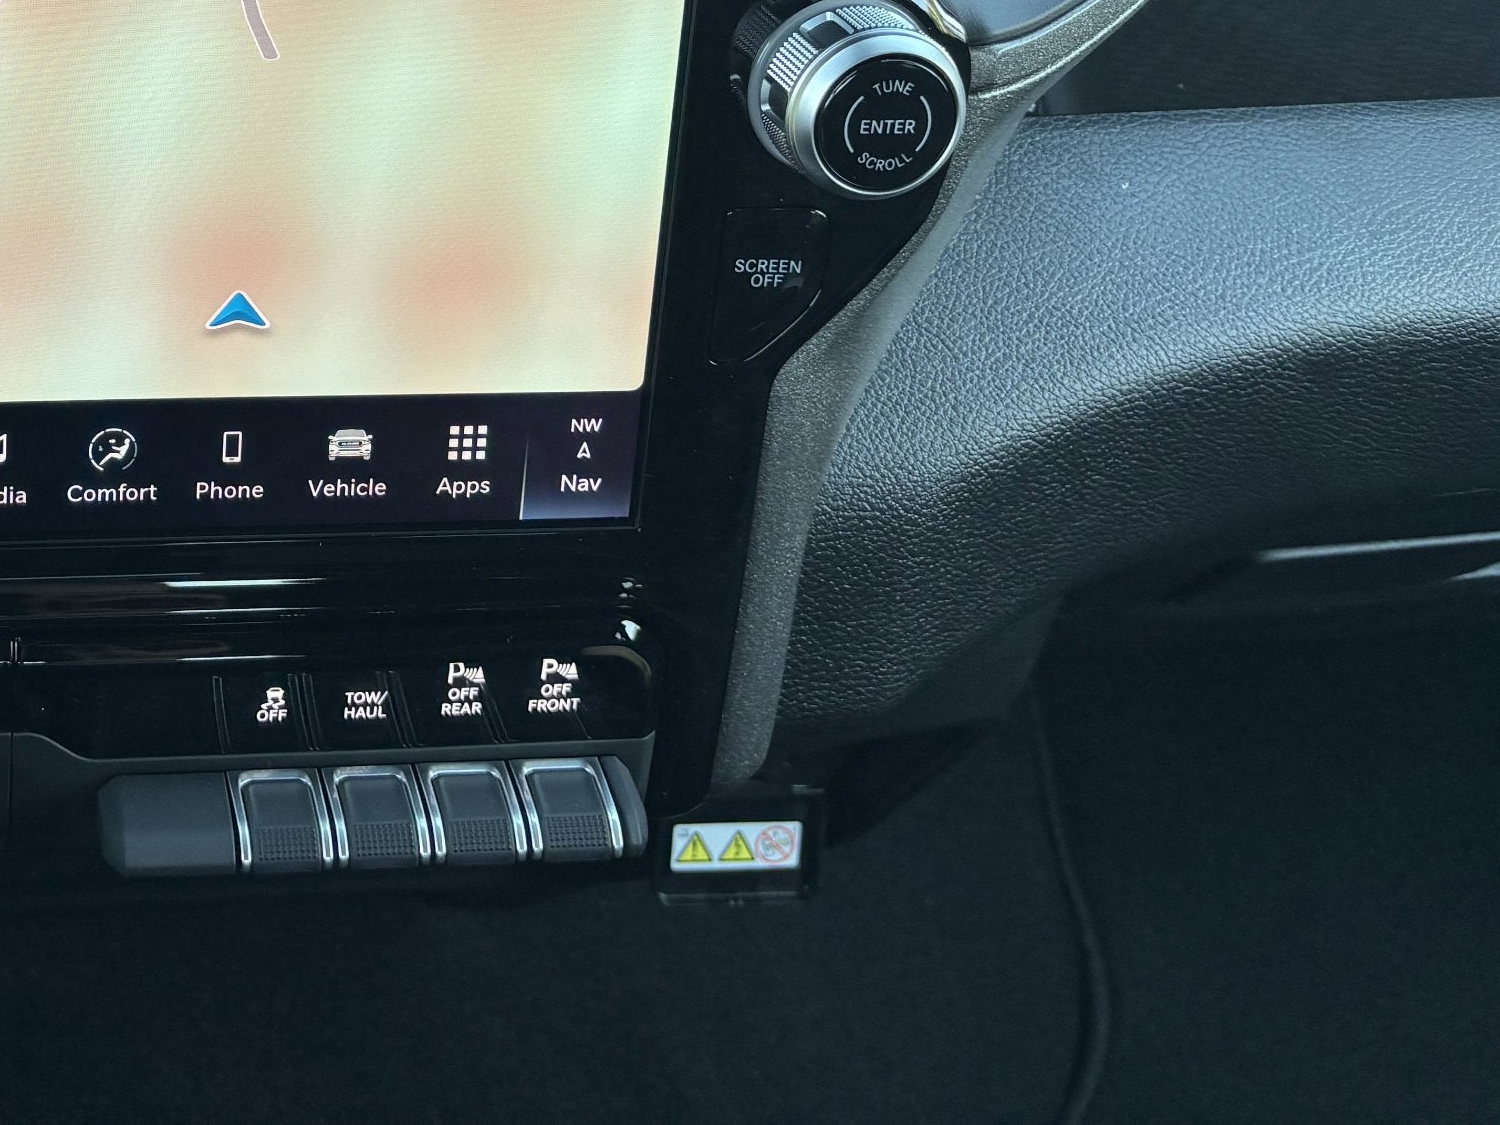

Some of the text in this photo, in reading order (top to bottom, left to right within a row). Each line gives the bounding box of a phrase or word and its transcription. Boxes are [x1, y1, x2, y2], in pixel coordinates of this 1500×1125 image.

[872, 79, 916, 97] TUNE
[859, 119, 916, 135] ENTER
[856, 150, 913, 172] SCROLL
[734, 259, 802, 274] SCREEN
[750, 274, 785, 288] OFF
[570, 418, 603, 434] NW
[195, 481, 264, 501] Phone
[307, 478, 387, 499] Vehicle
[436, 476, 492, 498] Apps
[560, 474, 603, 494] Nav
[66, 482, 158, 503] Comfort
[447, 687, 479, 702] OFF
[540, 683, 571, 698] OFF
[345, 691, 389, 706] TOW/
[527, 698, 580, 713] FRONT
[257, 709, 287, 723] OFF
[344, 707, 387, 720] HAUL
[441, 702, 483, 717] REAR
